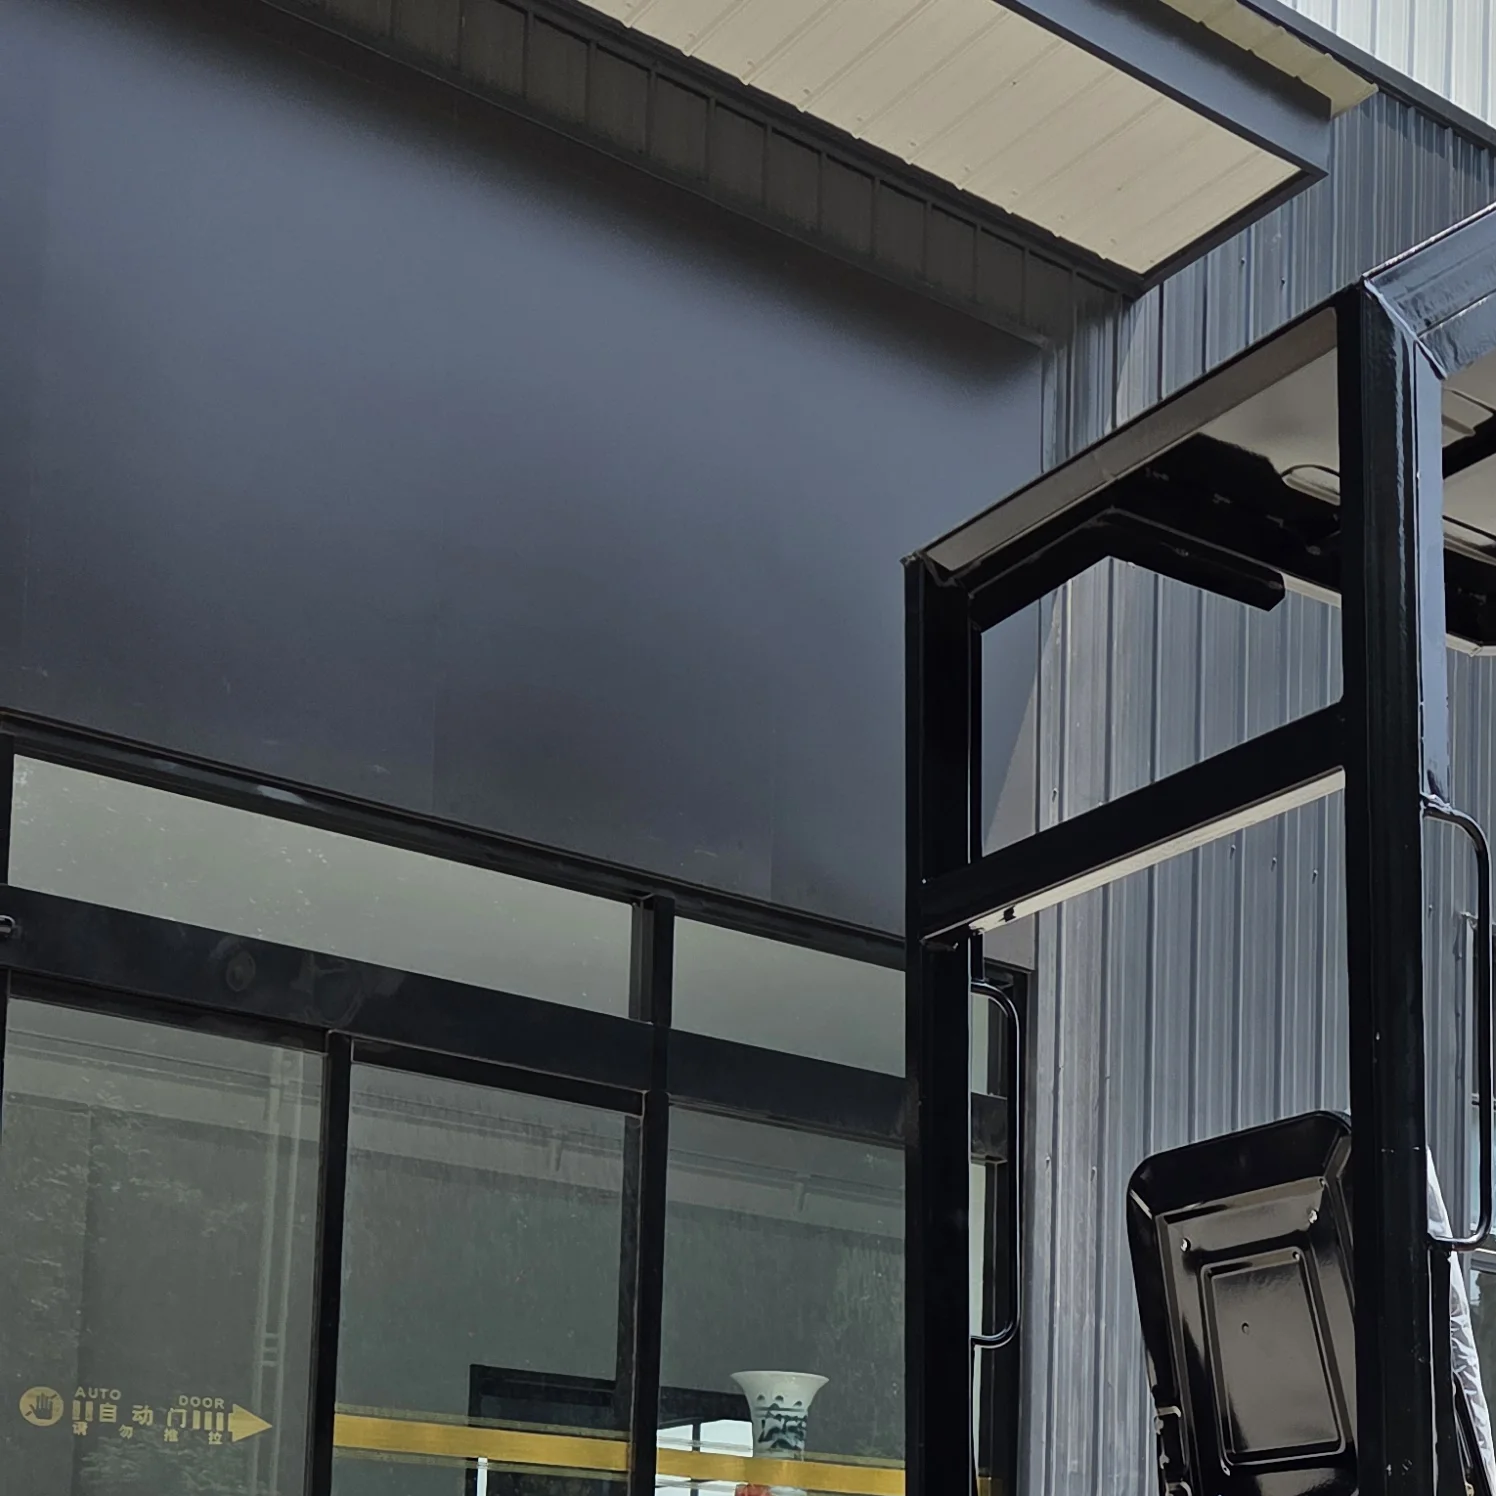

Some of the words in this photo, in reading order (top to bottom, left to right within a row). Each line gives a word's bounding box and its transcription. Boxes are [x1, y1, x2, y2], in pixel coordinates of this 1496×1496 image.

[75, 1386, 122, 1400] AUTO
[178, 1395, 225, 1410] DOOR
[98, 1401, 187, 1428] 自动门
[71, 1421, 223, 1445] 请勿推拉
